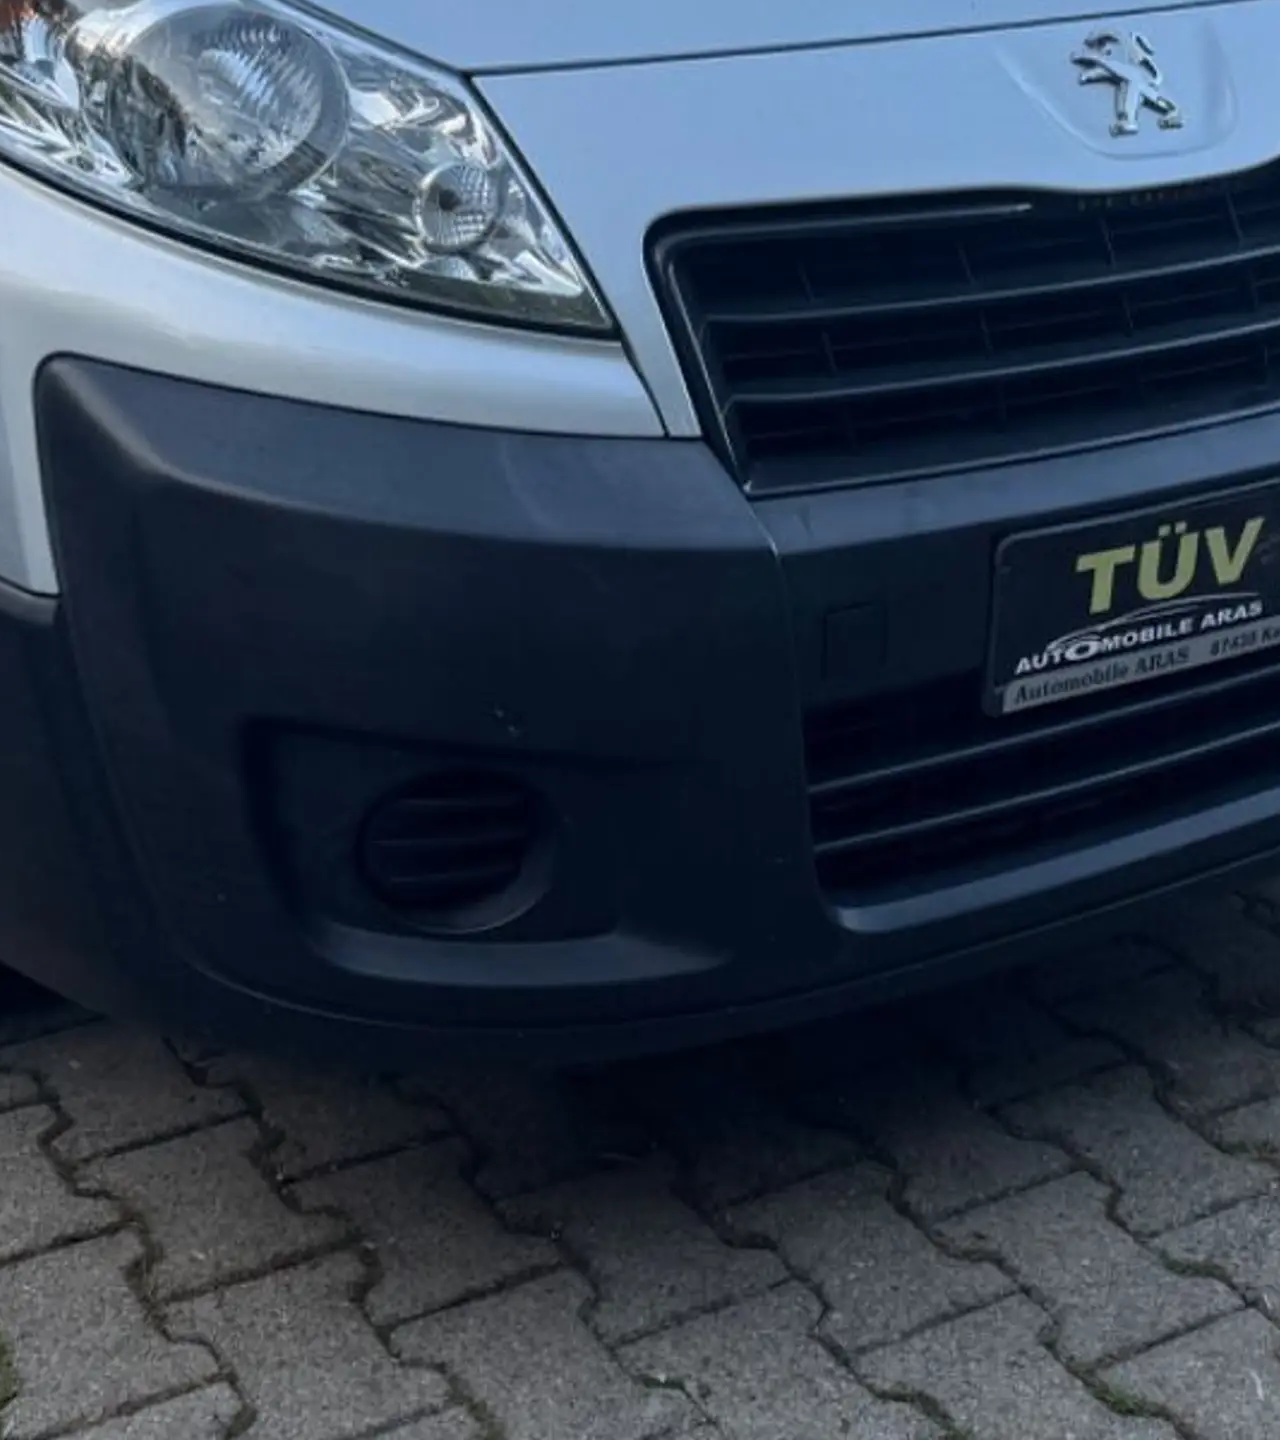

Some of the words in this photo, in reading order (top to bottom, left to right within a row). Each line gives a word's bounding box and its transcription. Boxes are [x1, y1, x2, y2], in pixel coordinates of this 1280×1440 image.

[1075, 516, 1266, 616] TÜV
[1014, 617, 1194, 676] AUTOMOBILE
[1200, 599, 1263, 630] ARAS
[1015, 661, 1129, 705] Automobile
[1134, 644, 1191, 674] ARAS
